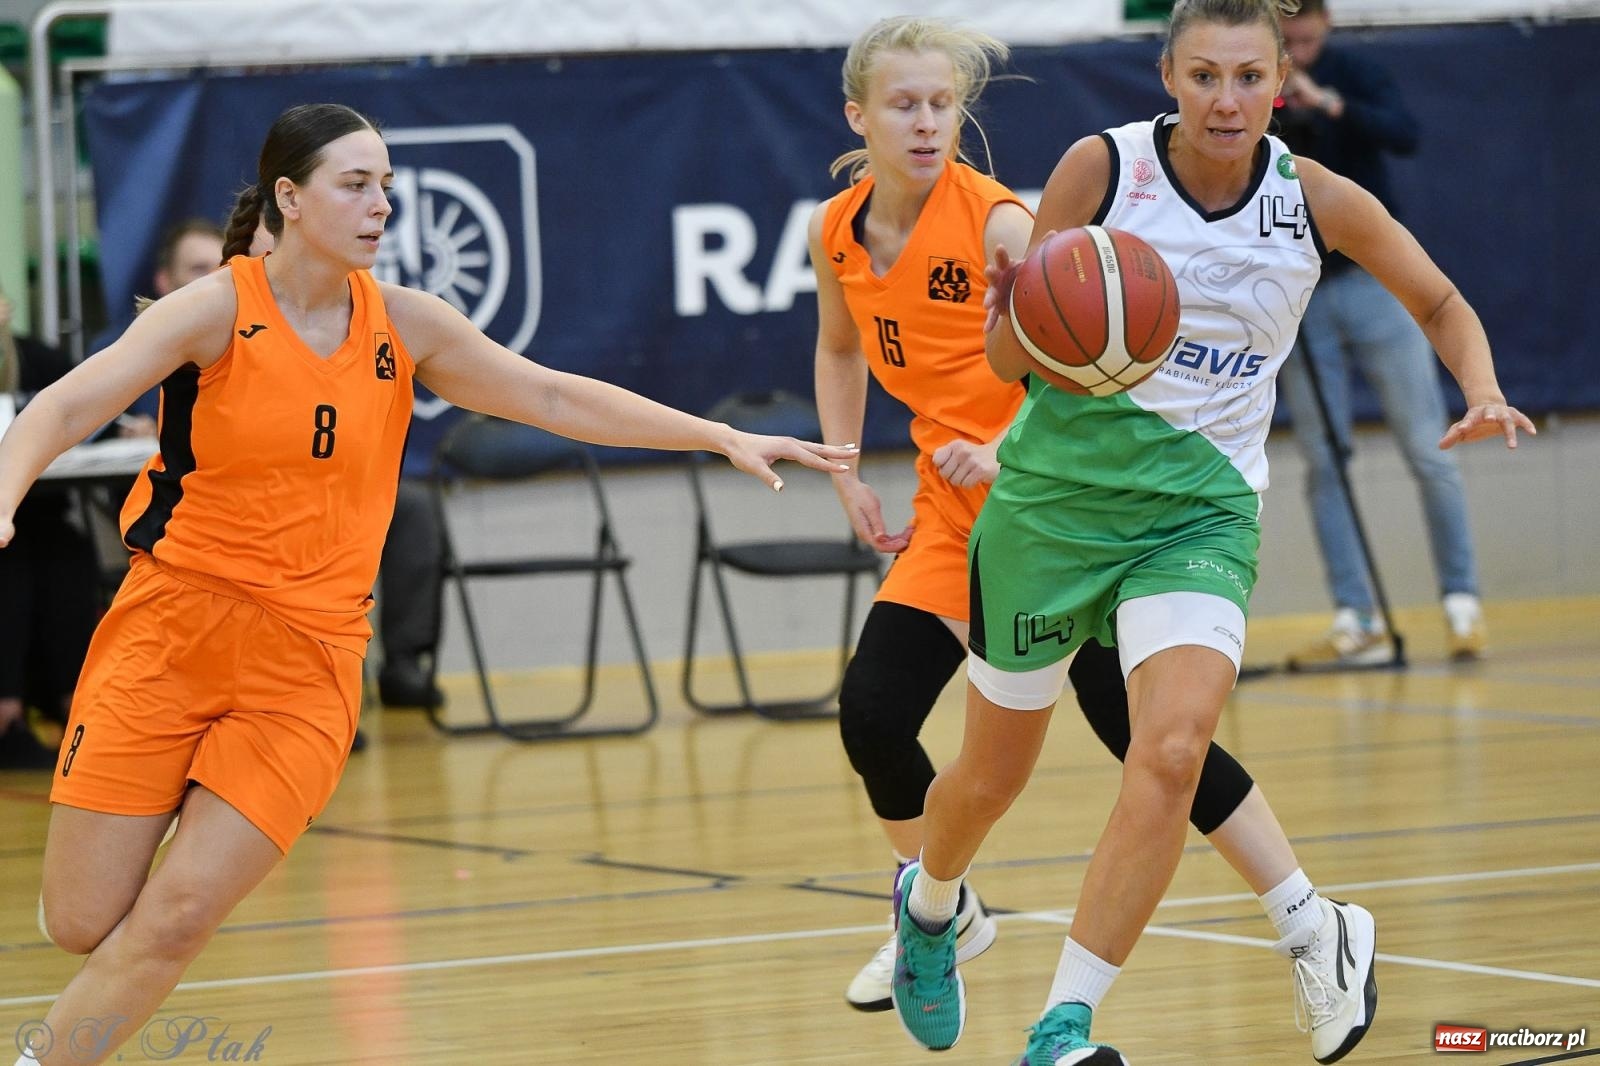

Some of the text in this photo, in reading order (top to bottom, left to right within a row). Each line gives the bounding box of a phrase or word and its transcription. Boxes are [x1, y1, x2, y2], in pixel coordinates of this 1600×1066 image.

[1259, 194, 1308, 239] 14
[873, 315, 906, 368] 15
[1157, 366, 1211, 387] RABIANIE
[311, 403, 338, 460] 8
[1014, 611, 1075, 657] 14
[62, 724, 85, 778] 8
